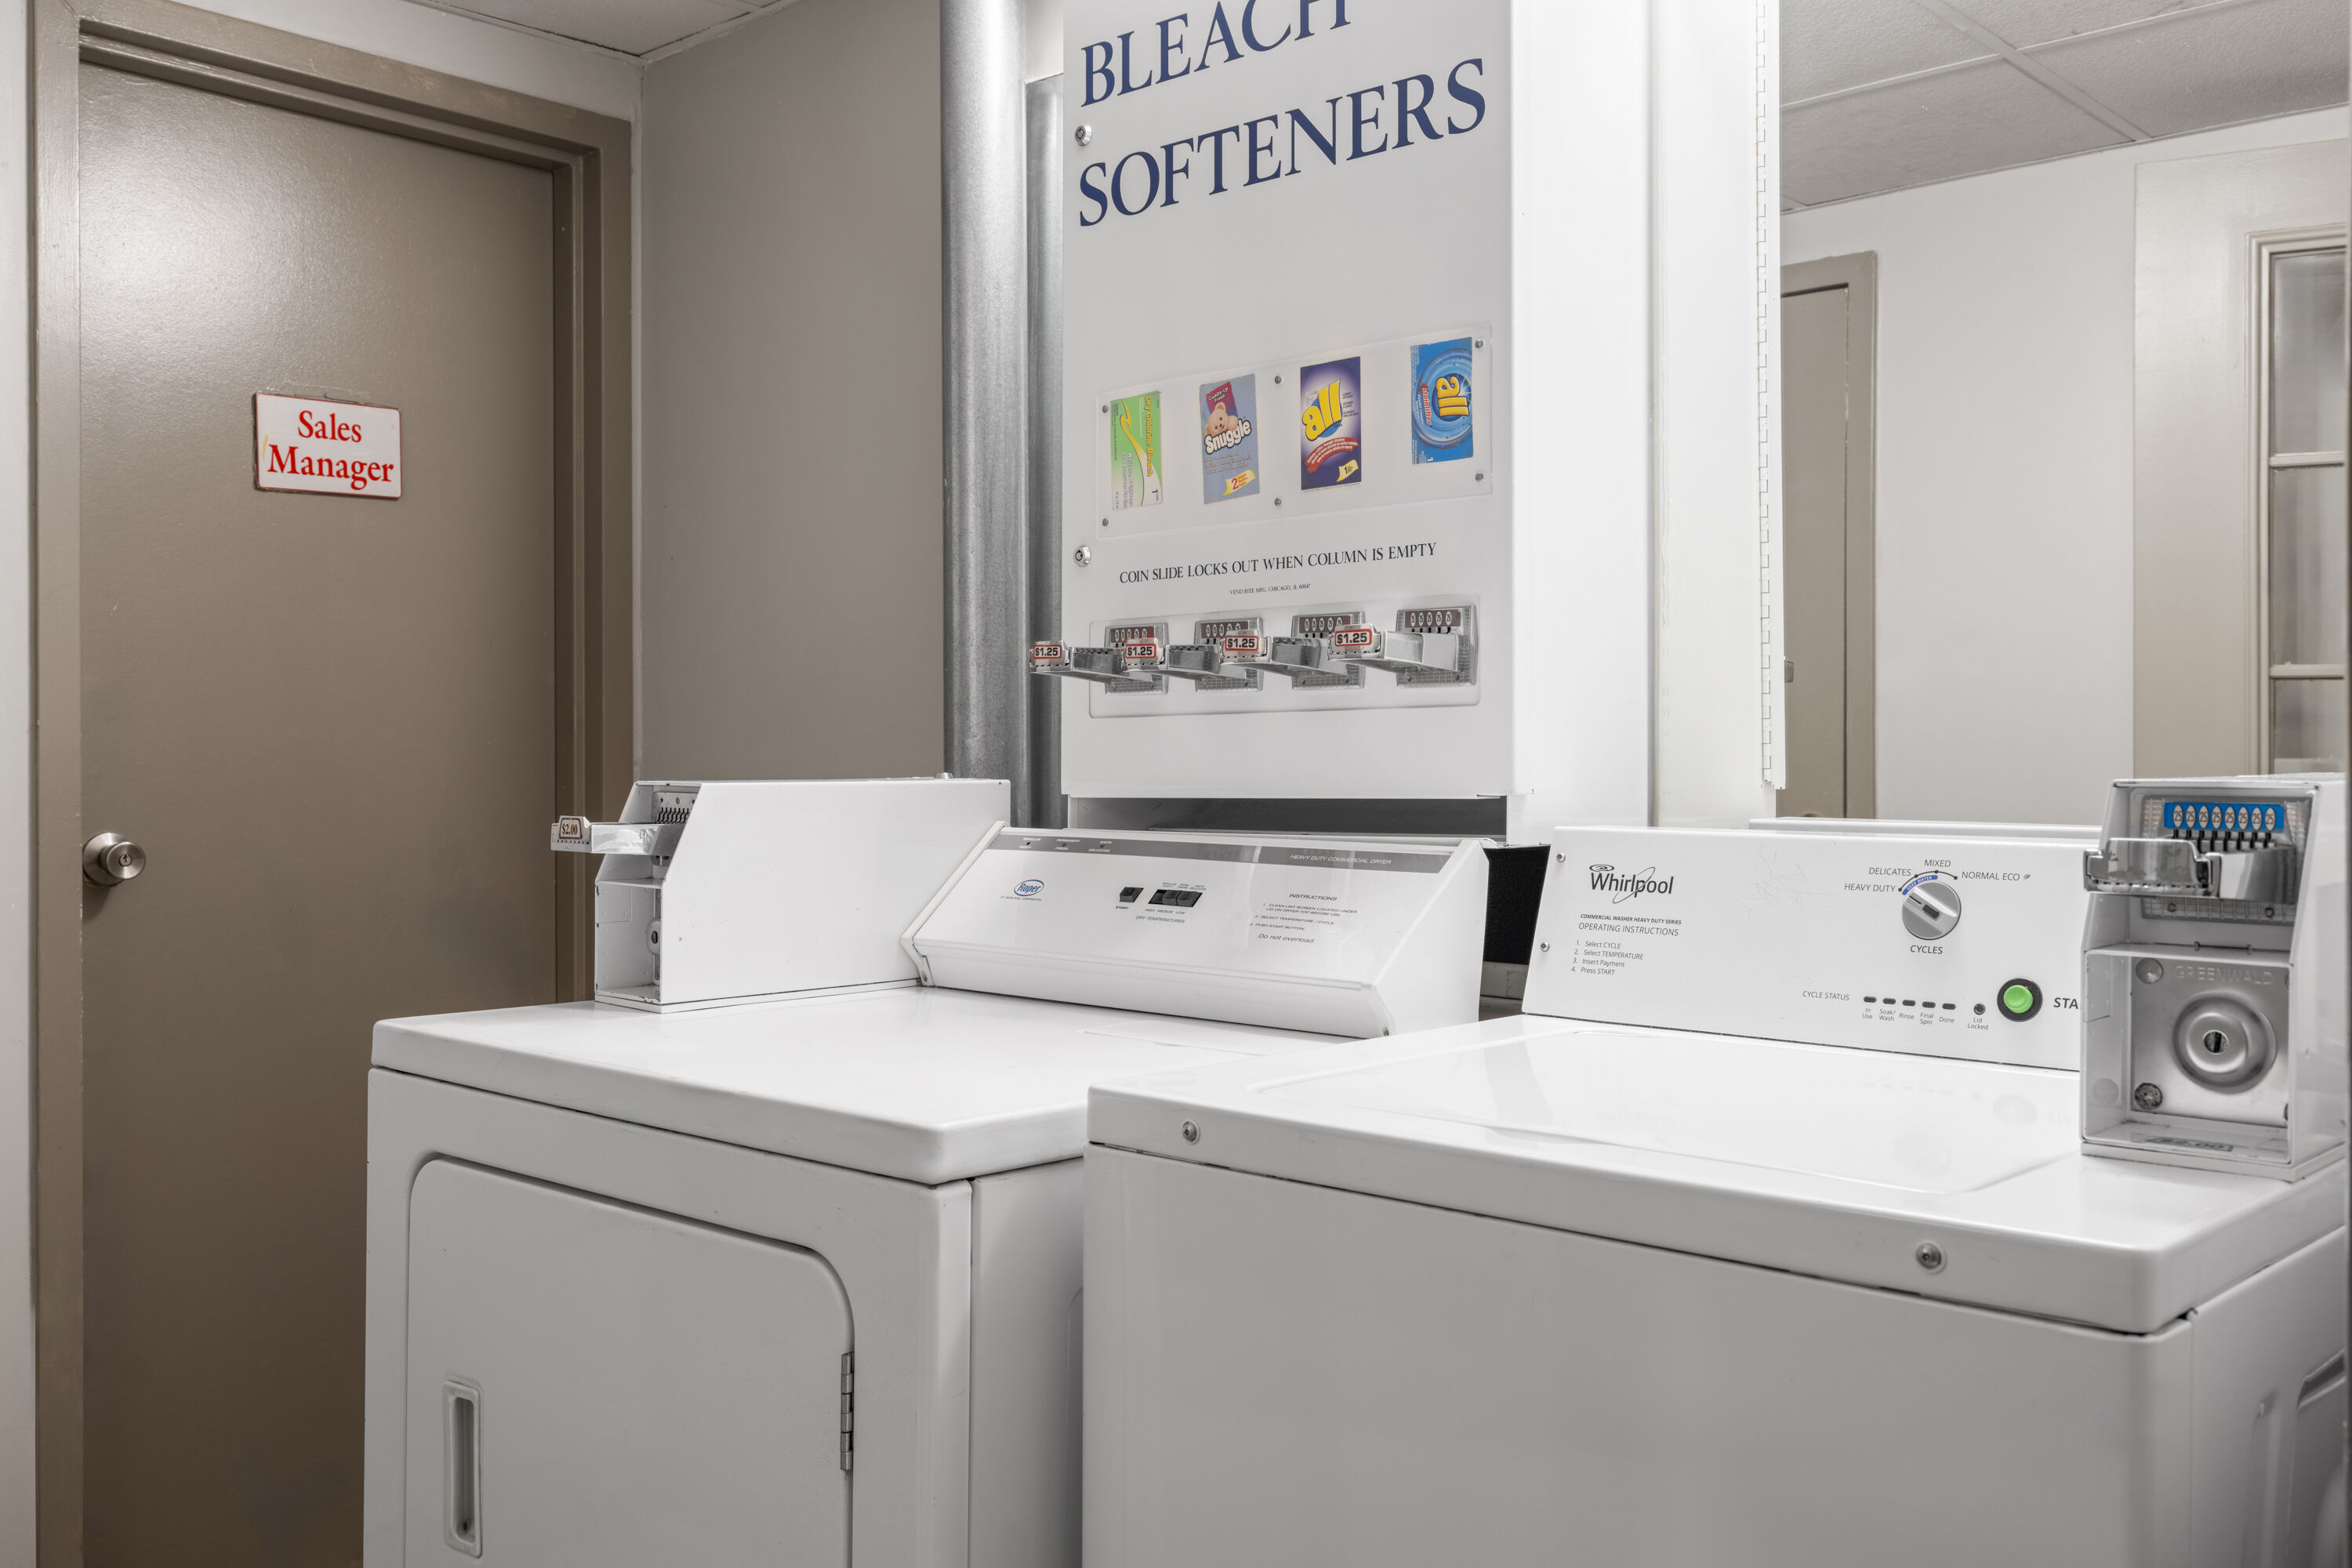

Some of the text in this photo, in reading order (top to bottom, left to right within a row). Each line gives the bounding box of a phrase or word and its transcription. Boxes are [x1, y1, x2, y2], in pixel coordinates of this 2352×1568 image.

[1079, 58, 1486, 227] SOFTENERS
[1436, 376, 1470, 417] all
[1144, 396, 1152, 410] Dry
[1302, 379, 1342, 441] all
[298, 410, 362, 443] Sales
[1204, 419, 1252, 454] Snuggle
[267, 444, 394, 491] Manager
[1232, 477, 1239, 490] 2
[1120, 543, 1436, 583] COIN SLIDE LOCKS OUT WHEN COLUMN IS EMPTY
[1227, 638, 1254, 648] $1.25
[1337, 632, 1367, 644] $1.25
[1035, 647, 1058, 656] $1.25
[1127, 647, 1152, 656] $1.25
[2174, 811, 2274, 825] 25 25 25 25 25 25 25 25
[561, 824, 578, 836] $2.00
[1924, 859, 1951, 868] MIXED
[1868, 867, 1912, 877] DELICATES
[1962, 871, 2020, 881] NORMAL ECO
[1018, 883, 1041, 894] Roper
[1590, 872, 1675, 898] Whirlpool
[1844, 883, 1896, 892] HEAVY DUTY
[1907, 881, 1917, 891] DEEP
[1578, 922, 1679, 936] OPERATING INSTRUCTIONS
[1602, 950, 1643, 960] TEMPERATURE
[1910, 945, 1944, 954] CYCLES
[2176, 965, 2273, 985] GREENWALD
[1802, 990, 1850, 1001] CYCLE STATUS
[2053, 997, 2079, 1010] STA
